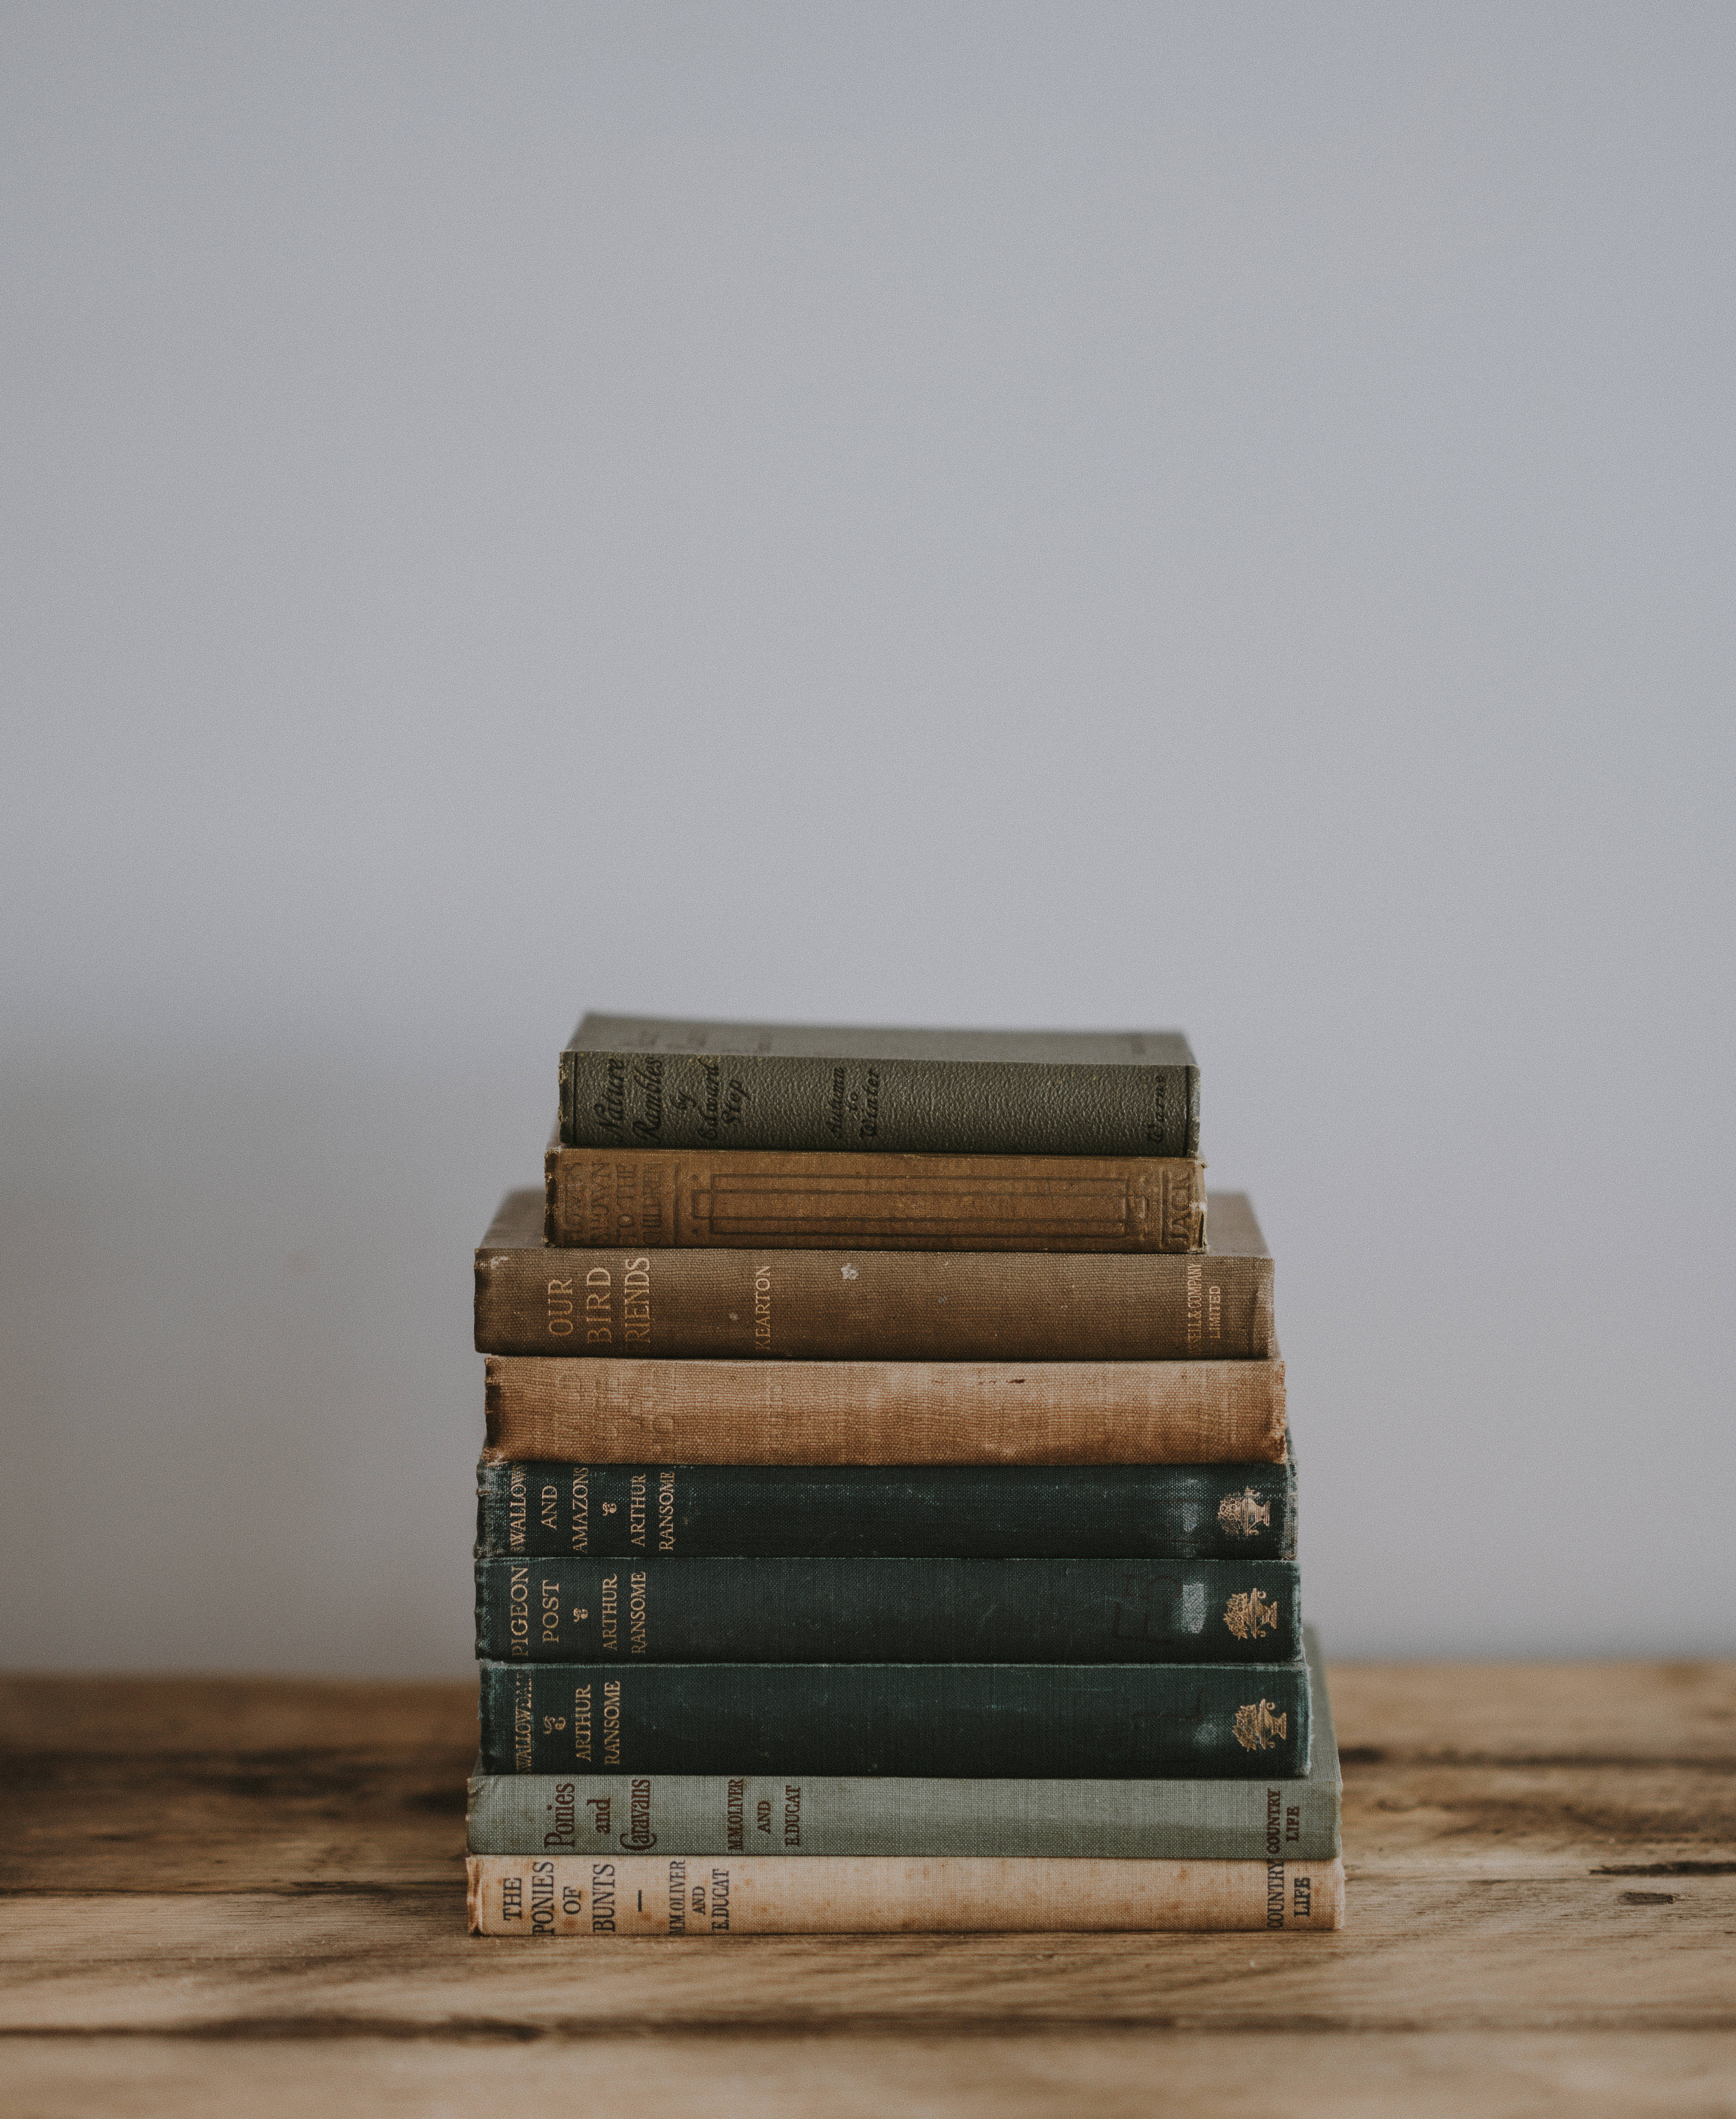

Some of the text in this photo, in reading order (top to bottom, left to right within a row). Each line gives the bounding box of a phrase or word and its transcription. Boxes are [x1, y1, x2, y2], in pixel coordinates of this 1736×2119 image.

[593, 1058, 624, 1143] Nature
[632, 1056, 662, 1144] Rambles
[670, 1091, 696, 1110] by
[697, 1058, 718, 1140] Edward
[721, 1079, 750, 1124] Step
[825, 1067, 844, 1139] Autumn
[847, 1092, 858, 1112] to
[859, 1068, 879, 1140] Winter
[548, 1278, 573, 1336] OUR
[587, 1267, 612, 1343] BIRD
[625, 1257, 650, 1352] RIENDS
[755, 1265, 771, 1350] KEARTON
[1188, 1263, 1202, 1308] COMPANY
[1188, 1310, 1202, 1319] &
[1209, 1286, 1221, 1339] LIMITED
[541, 1485, 558, 1530] AND
[573, 1467, 589, 1553] AMAZONS
[631, 1473, 646, 1547] ARTHUR
[659, 1471, 675, 1551] RANSOME
[511, 1566, 528, 1656] PIGEON
[542, 1580, 560, 1643] POST
[602, 1573, 618, 1651] ARTHUR
[631, 1571, 646, 1654] RANSOME
[575, 1684, 591, 1762] ARTHUR
[604, 1681, 621, 1765] RANSOME
[544, 1783, 575, 1848] Ponies
[587, 1797, 610, 1834] and
[619, 1779, 657, 1850] Caravans
[757, 1800, 771, 1835] AND
[785, 1785, 800, 1848] E.DUCAT
[1266, 1788, 1281, 1854] COUNTRY
[1286, 1806, 1299, 1842] LIFE
[502, 1877, 522, 1921] THE
[532, 1862, 554, 1935] PONIES
[563, 1886, 581, 1915] OF
[592, 1864, 615, 1932] BUNTS
[692, 1886, 705, 1915] AND
[711, 1869, 729, 1931] E.DUCAT
[1266, 1859, 1284, 1929] COUNTRY
[1294, 1877, 1310, 1917] LIFE
